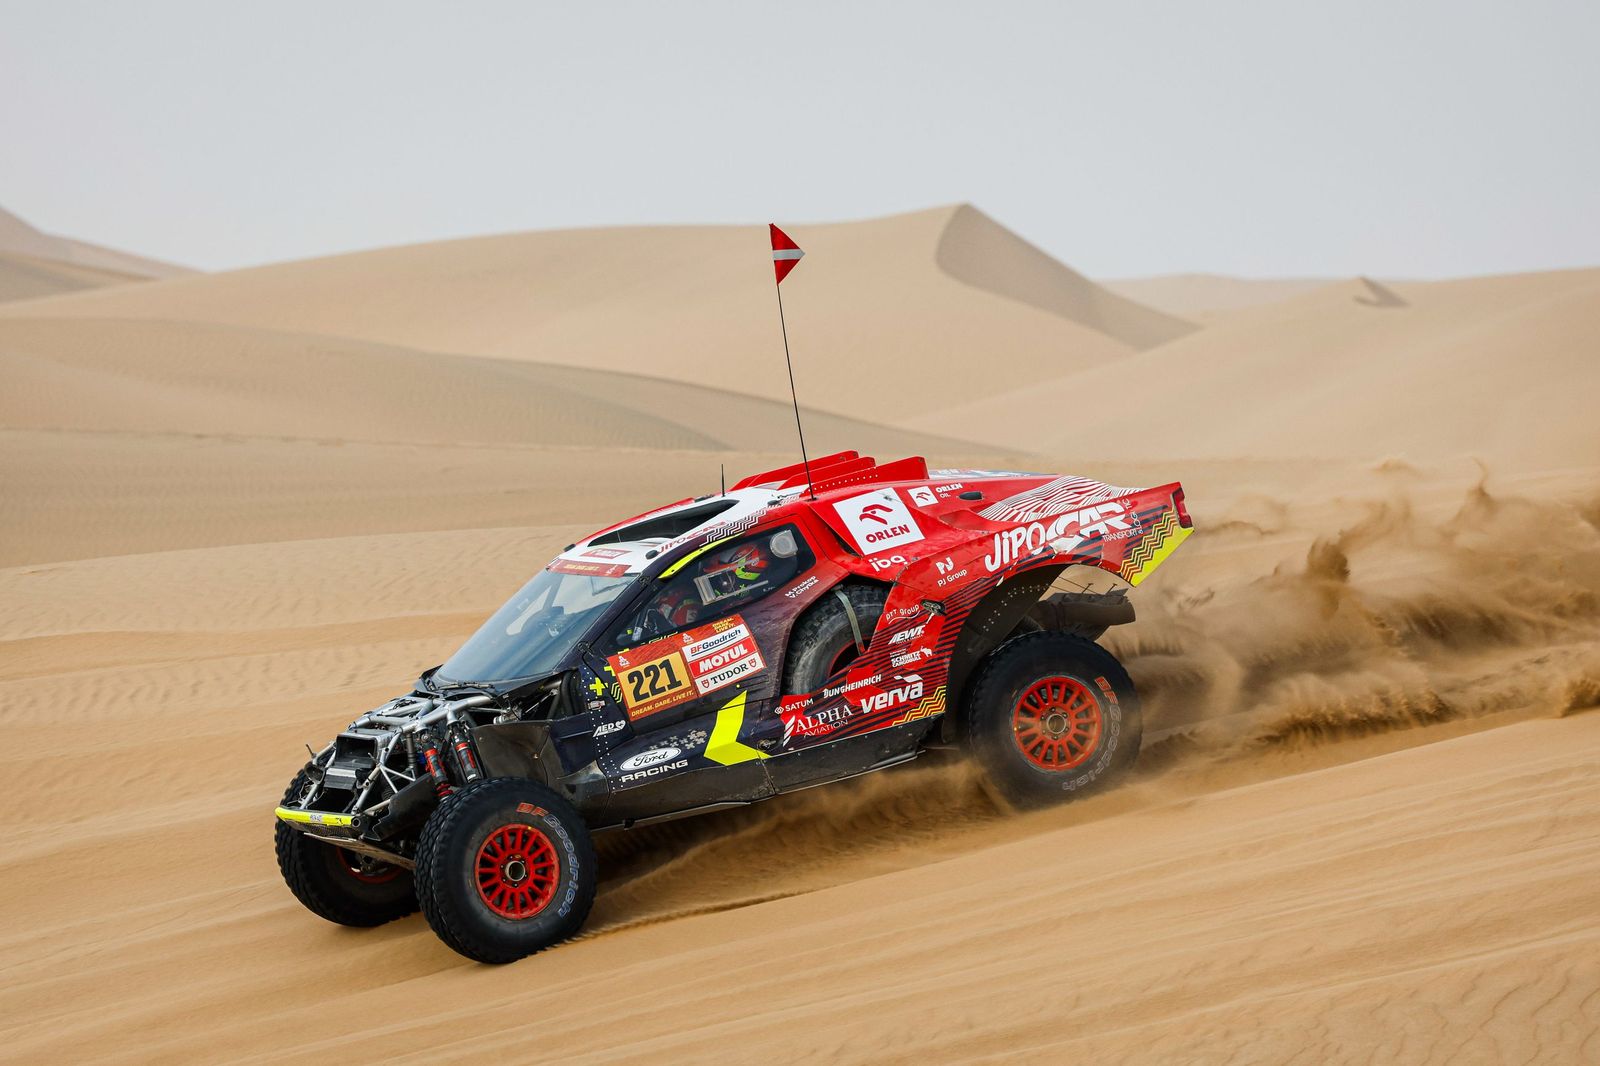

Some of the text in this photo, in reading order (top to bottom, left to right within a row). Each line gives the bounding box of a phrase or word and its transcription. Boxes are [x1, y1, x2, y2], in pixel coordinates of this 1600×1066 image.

[935, 483, 963, 493] ORLEN
[865, 524, 910, 543] ORLEN
[937, 569, 968, 587] PJ Group
[899, 604, 919, 615] group
[690, 629, 741, 654] BFGoodrich
[699, 643, 748, 673] MOTUL
[627, 659, 682, 703] 221
[710, 663, 748, 685] TUDOR
[822, 674, 882, 699] JUNGHEINRICH
[631, 705, 654, 717] DREAM.
[672, 692, 686, 702] LIVE
[785, 698, 814, 712] SATUM
[795, 704, 853, 733] ALPHA
[803, 719, 849, 738] AVIATION
[634, 750, 670, 767] Ford
[621, 759, 689, 783] RACING
